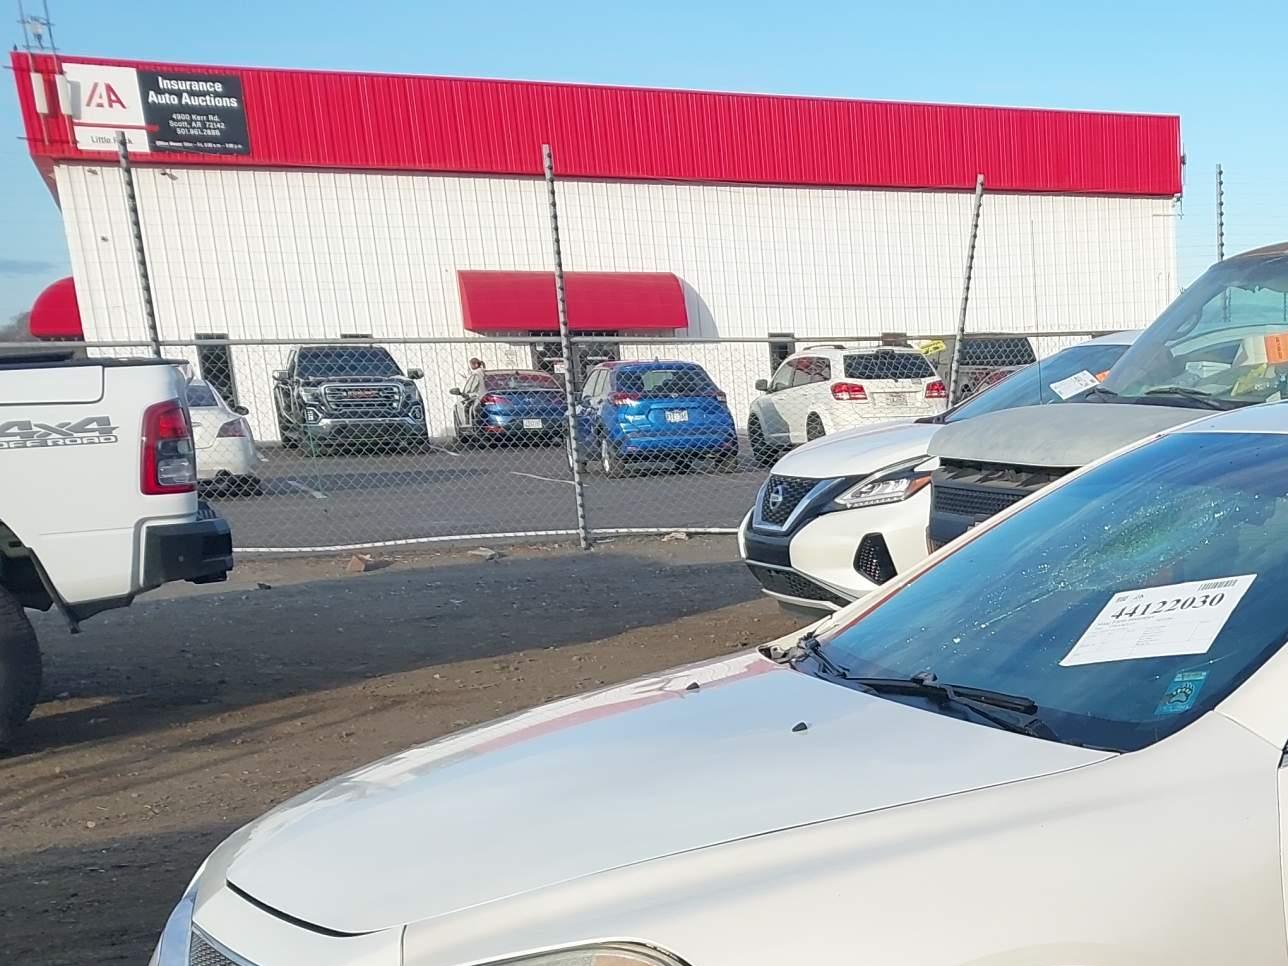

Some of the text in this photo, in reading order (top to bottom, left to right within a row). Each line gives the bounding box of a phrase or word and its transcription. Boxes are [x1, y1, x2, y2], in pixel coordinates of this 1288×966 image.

[158, 76, 223, 91] Insurance
[148, 91, 238, 107] Auto Auctions
[90, 135, 111, 143] Little
[46, 435, 117, 446] ROAD
[1111, 593, 1225, 619] 44122030
